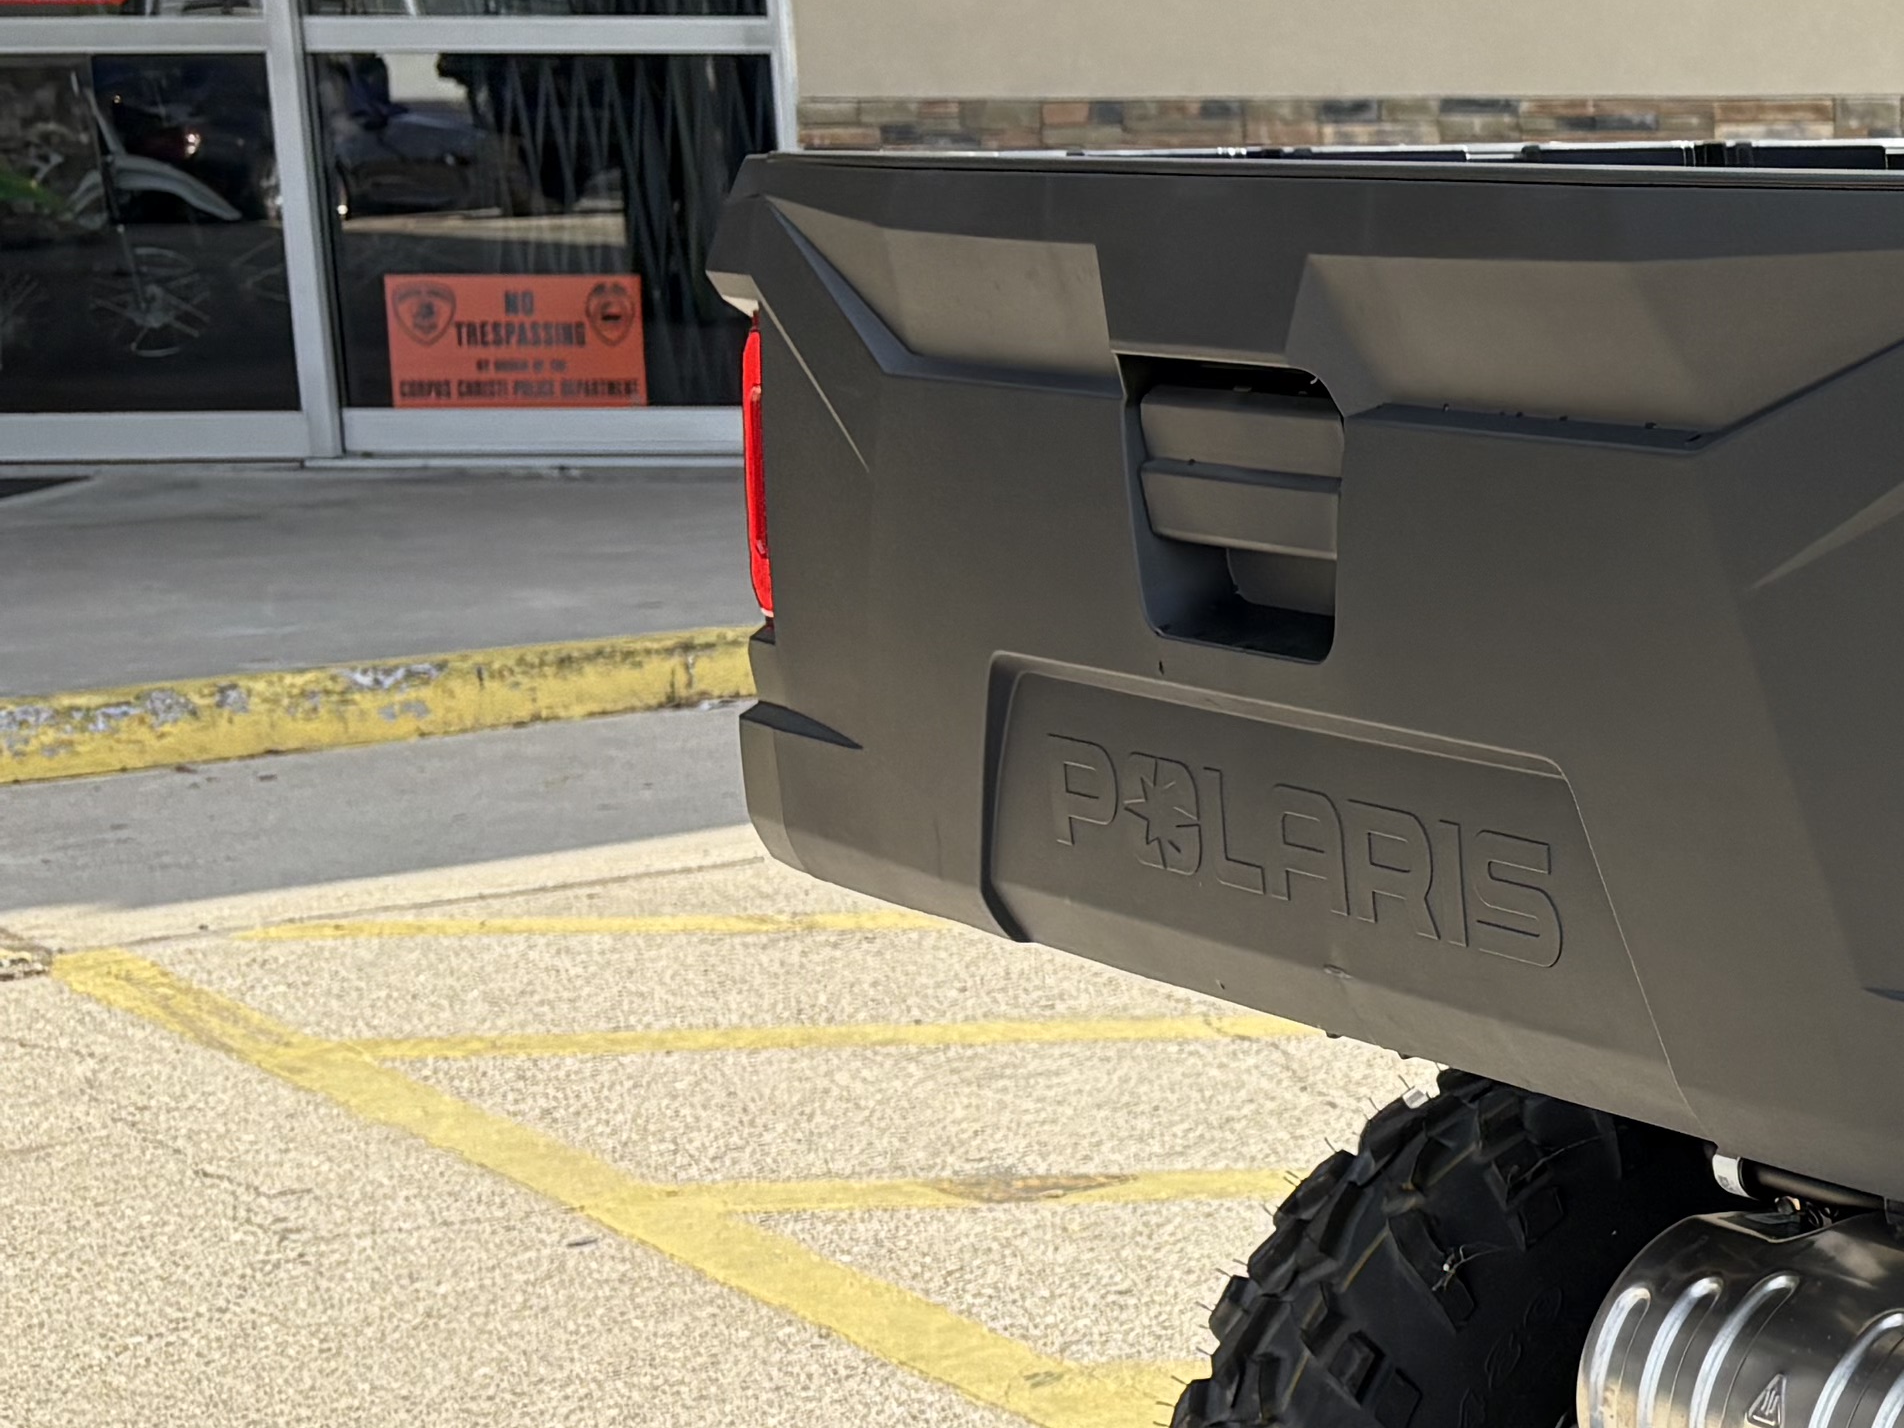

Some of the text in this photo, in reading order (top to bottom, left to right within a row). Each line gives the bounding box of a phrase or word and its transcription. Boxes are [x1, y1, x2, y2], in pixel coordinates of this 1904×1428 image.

[505, 291, 534, 316] NO
[455, 321, 586, 347] TRESPASSING
[1047, 732, 1564, 968] POLARIS
